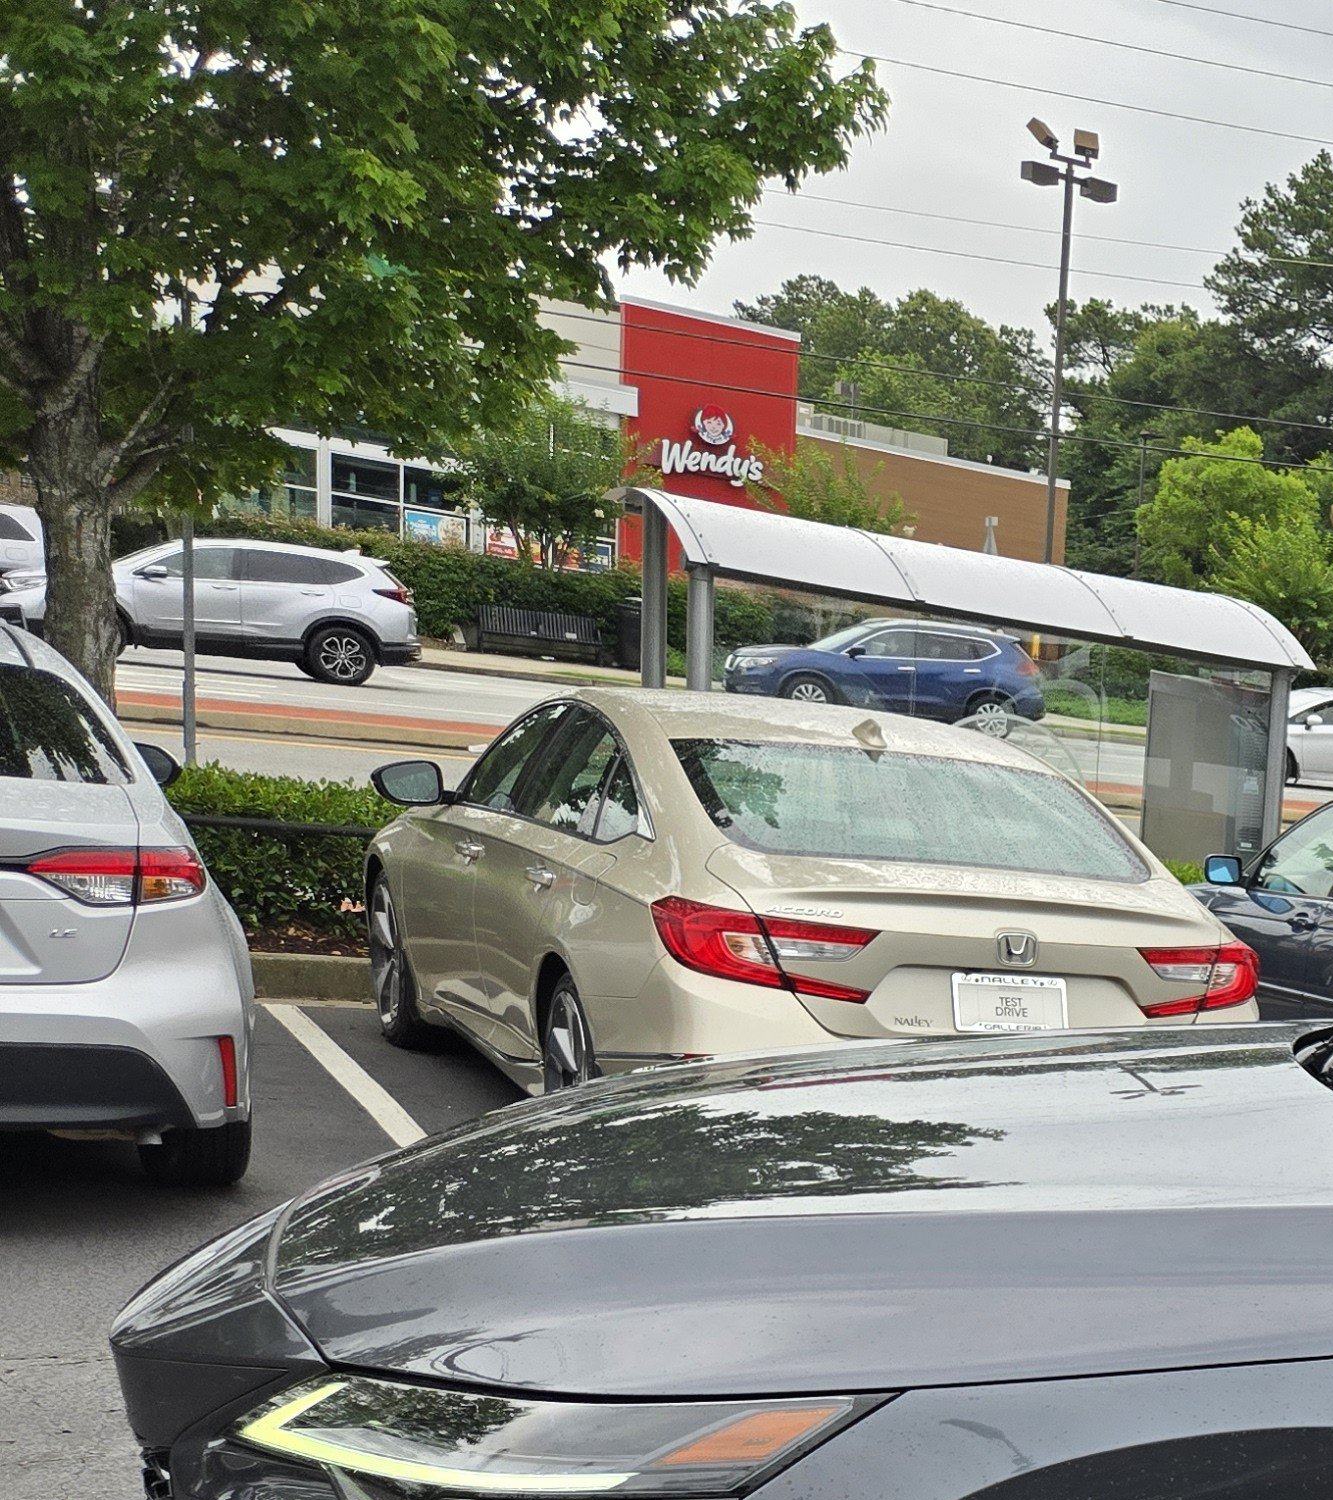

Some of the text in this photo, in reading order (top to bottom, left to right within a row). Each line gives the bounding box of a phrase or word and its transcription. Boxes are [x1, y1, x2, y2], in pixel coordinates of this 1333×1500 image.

[662, 439, 764, 487] Wendy's
[766, 904, 845, 918] ACCORD
[49, 928, 78, 938] LE
[980, 975, 1040, 986] NALLEY
[999, 996, 1023, 1008] TEST
[995, 1006, 1029, 1018] DRIVE
